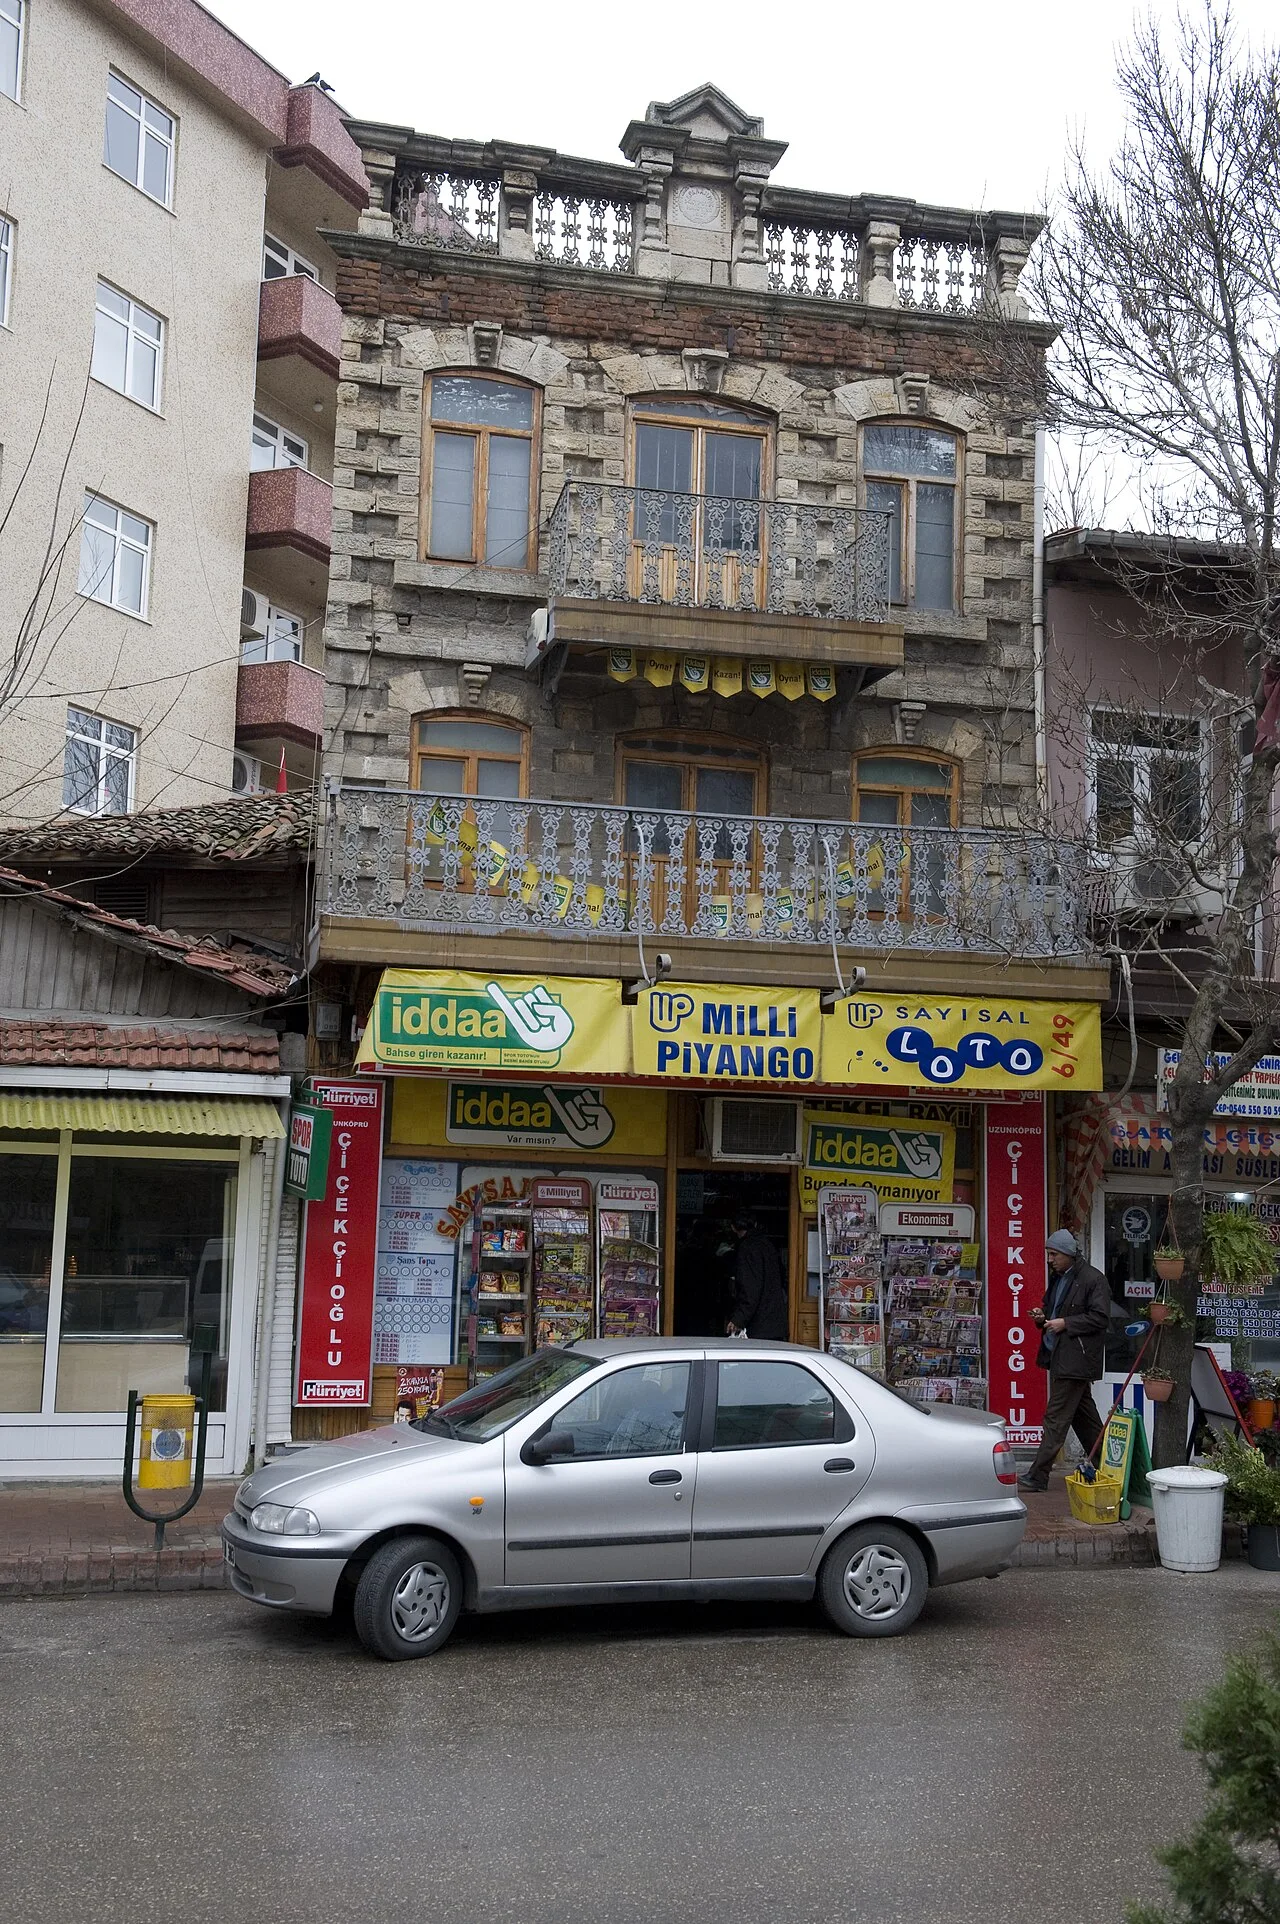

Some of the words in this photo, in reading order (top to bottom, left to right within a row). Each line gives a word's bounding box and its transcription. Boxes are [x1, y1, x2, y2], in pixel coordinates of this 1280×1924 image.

[649, 660, 672, 672] Oyna!
[714, 671, 740, 679] Kazan!
[780, 675, 801, 683] Oyna!
[392, 997, 506, 1038] iddaa
[896, 1006, 1029, 1024] SAYISAL
[1051, 1014, 1078, 1078] 6/49
[386, 1048, 415, 1058] Bahse
[418, 1049, 444, 1060] giren
[447, 1050, 487, 1060] kazanır!
[900, 1032, 1032, 1078] LOTO
[322, 1090, 374, 1106] Hürriyet
[455, 1090, 551, 1127] iddaa
[1249, 1105, 1261, 1115] 550
[1264, 1106, 1272, 1115] 50
[292, 1117, 312, 1149] SPOR
[989, 1126, 1042, 1135] UZUNKÖPRÜ
[507, 1135, 524, 1143] Var
[526, 1136, 556, 1145] mısın?
[814, 1131, 898, 1168] iddaa
[1112, 1151, 1150, 1169] GELİN
[289, 1153, 308, 1185] TOTO
[546, 1187, 580, 1197] Milliyet
[602, 1186, 656, 1200] Hürriyet
[830, 1193, 866, 1203] Hürriyet
[394, 1210, 421, 1220] SÜPER
[902, 1213, 950, 1226] Ekonomist
[1006, 1141, 1026, 1427] ÇİÇEKÇİOĞLU
[1202, 1284, 1226, 1293] SALON
[1127, 1286, 1152, 1296] AÇIK
[1214, 1299, 1231, 1307] 513
[1233, 1299, 1244, 1307] 53
[1216, 1308, 1239, 1317] 0544
[1240, 1309, 1257, 1317] 634
[1260, 1310, 1270, 1318] 38
[1216, 1318, 1239, 1327] 0542
[1242, 1319, 1259, 1328] 550
[1262, 1320, 1273, 1328] 50
[1216, 1328, 1239, 1337] 0535
[1242, 1328, 1259, 1337] 358
[1262, 1329, 1273, 1338] 30
[306, 1382, 361, 1399] Hürriyet
